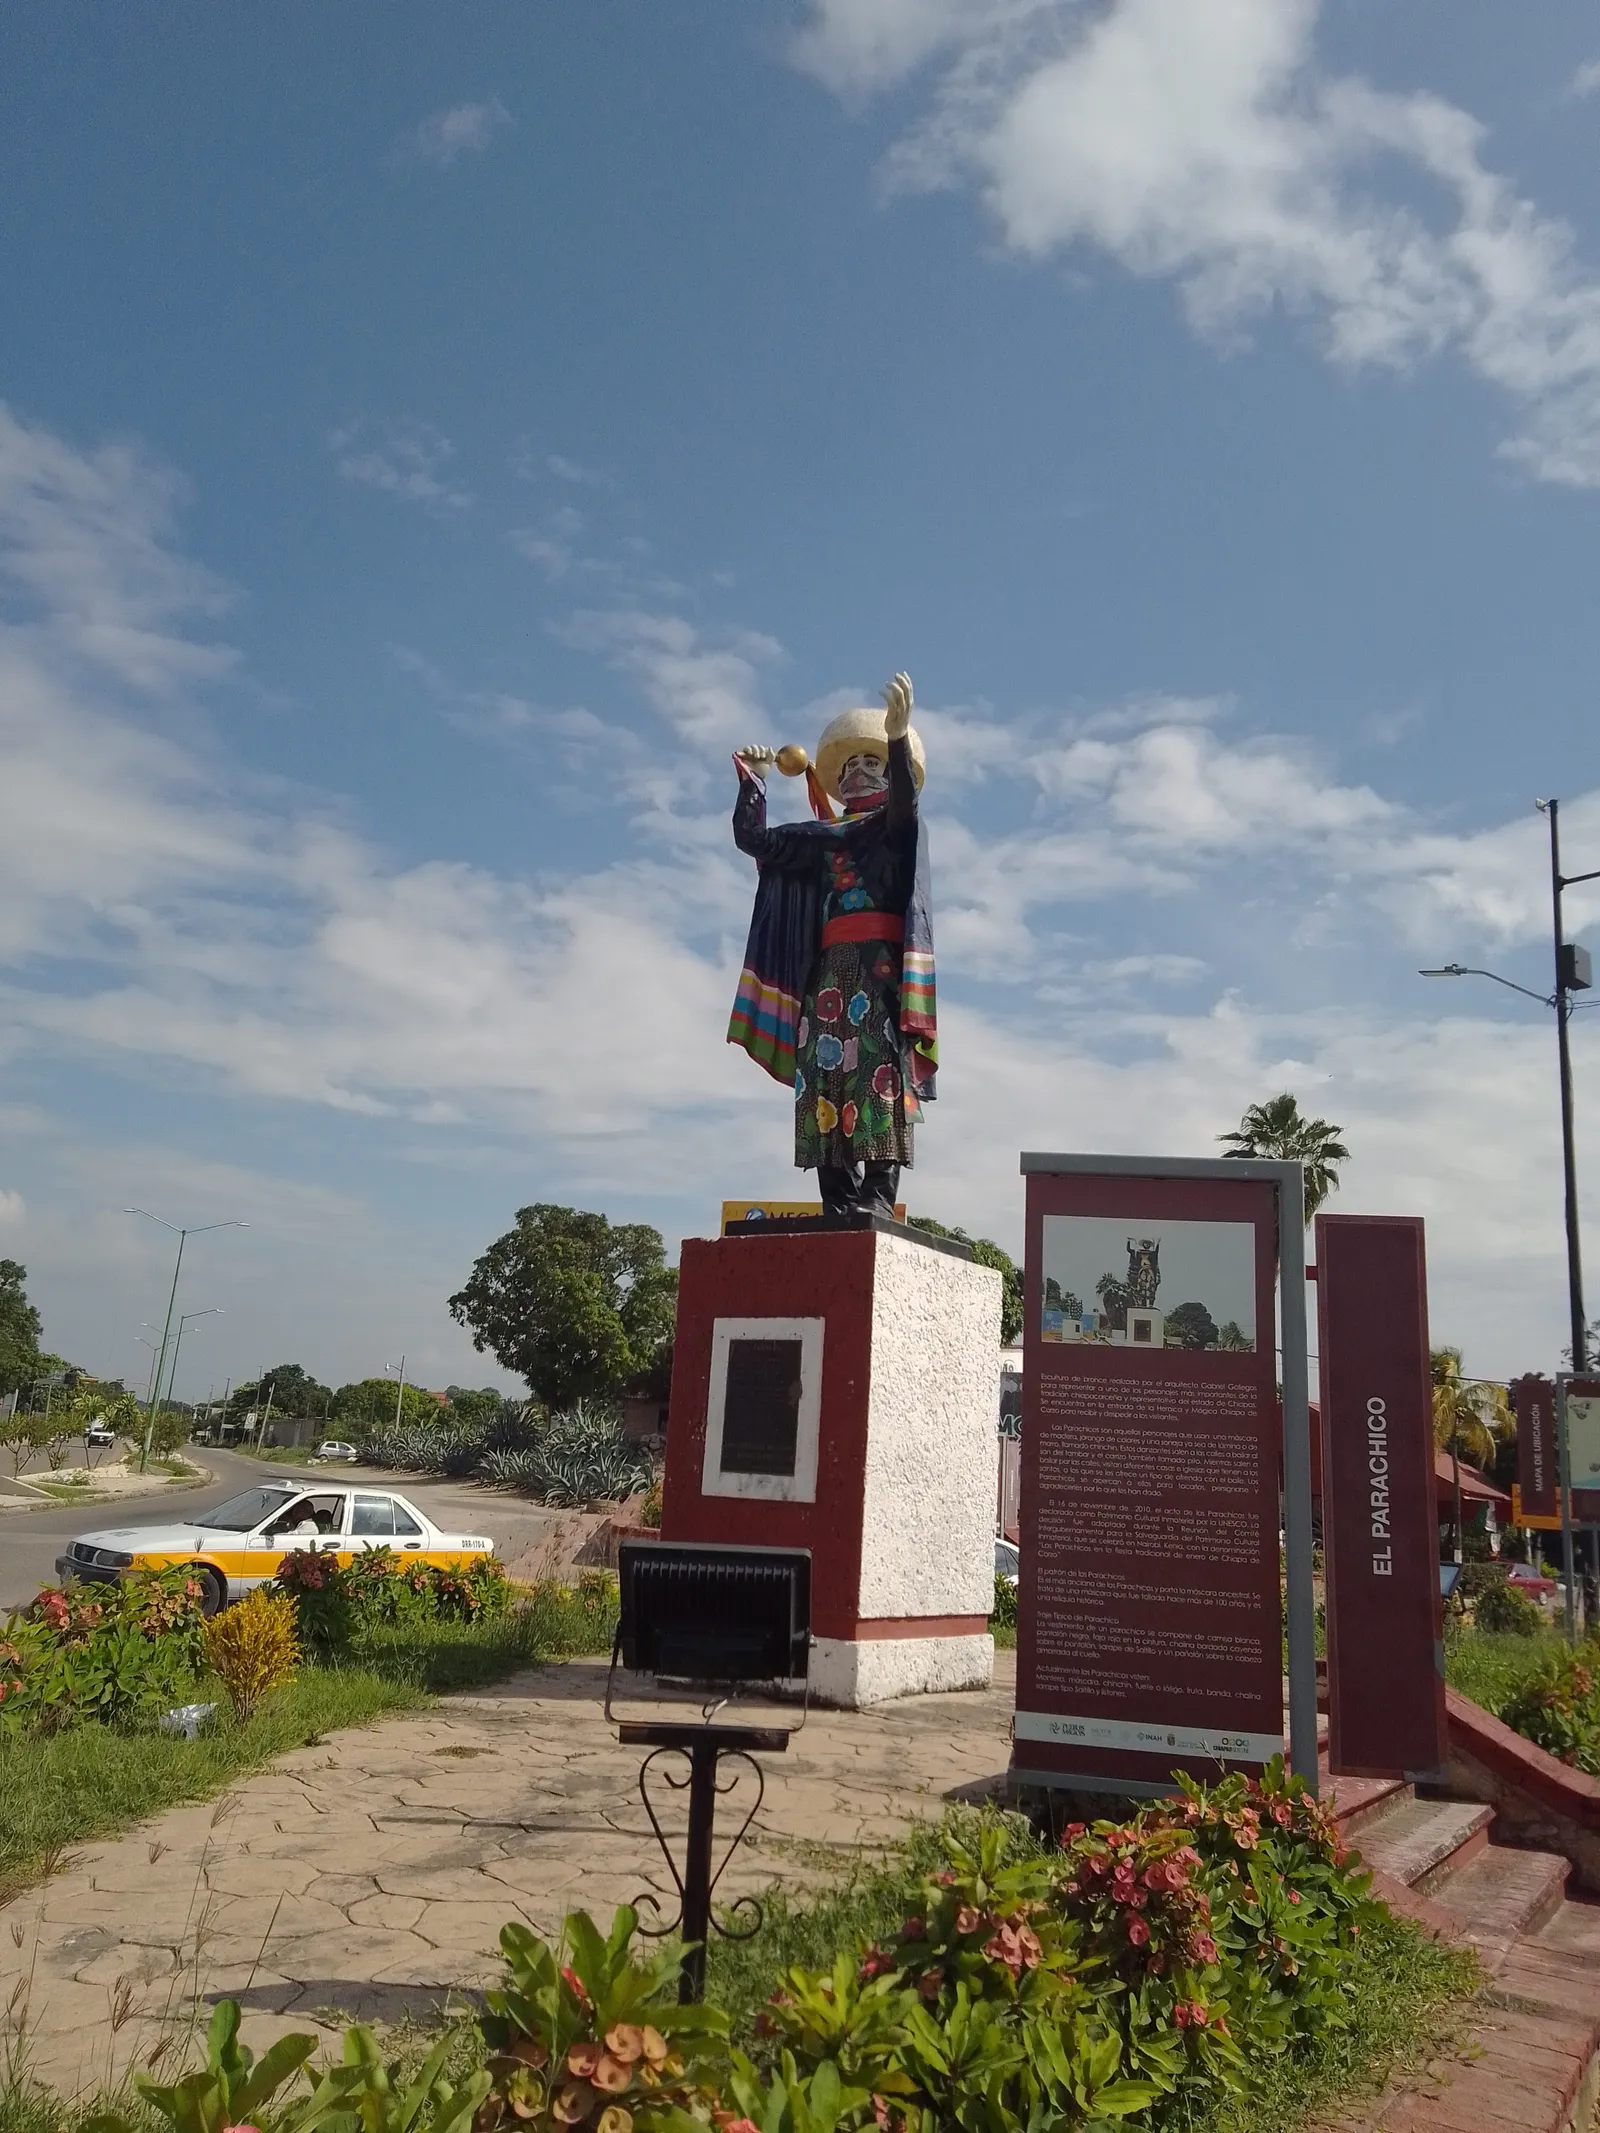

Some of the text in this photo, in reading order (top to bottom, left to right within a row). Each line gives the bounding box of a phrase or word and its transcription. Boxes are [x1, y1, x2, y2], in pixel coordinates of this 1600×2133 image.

[1366, 1396, 1392, 1576] EL PARACHICO
[1531, 1404, 1543, 1492] MAPA DE UBICACIÓN
